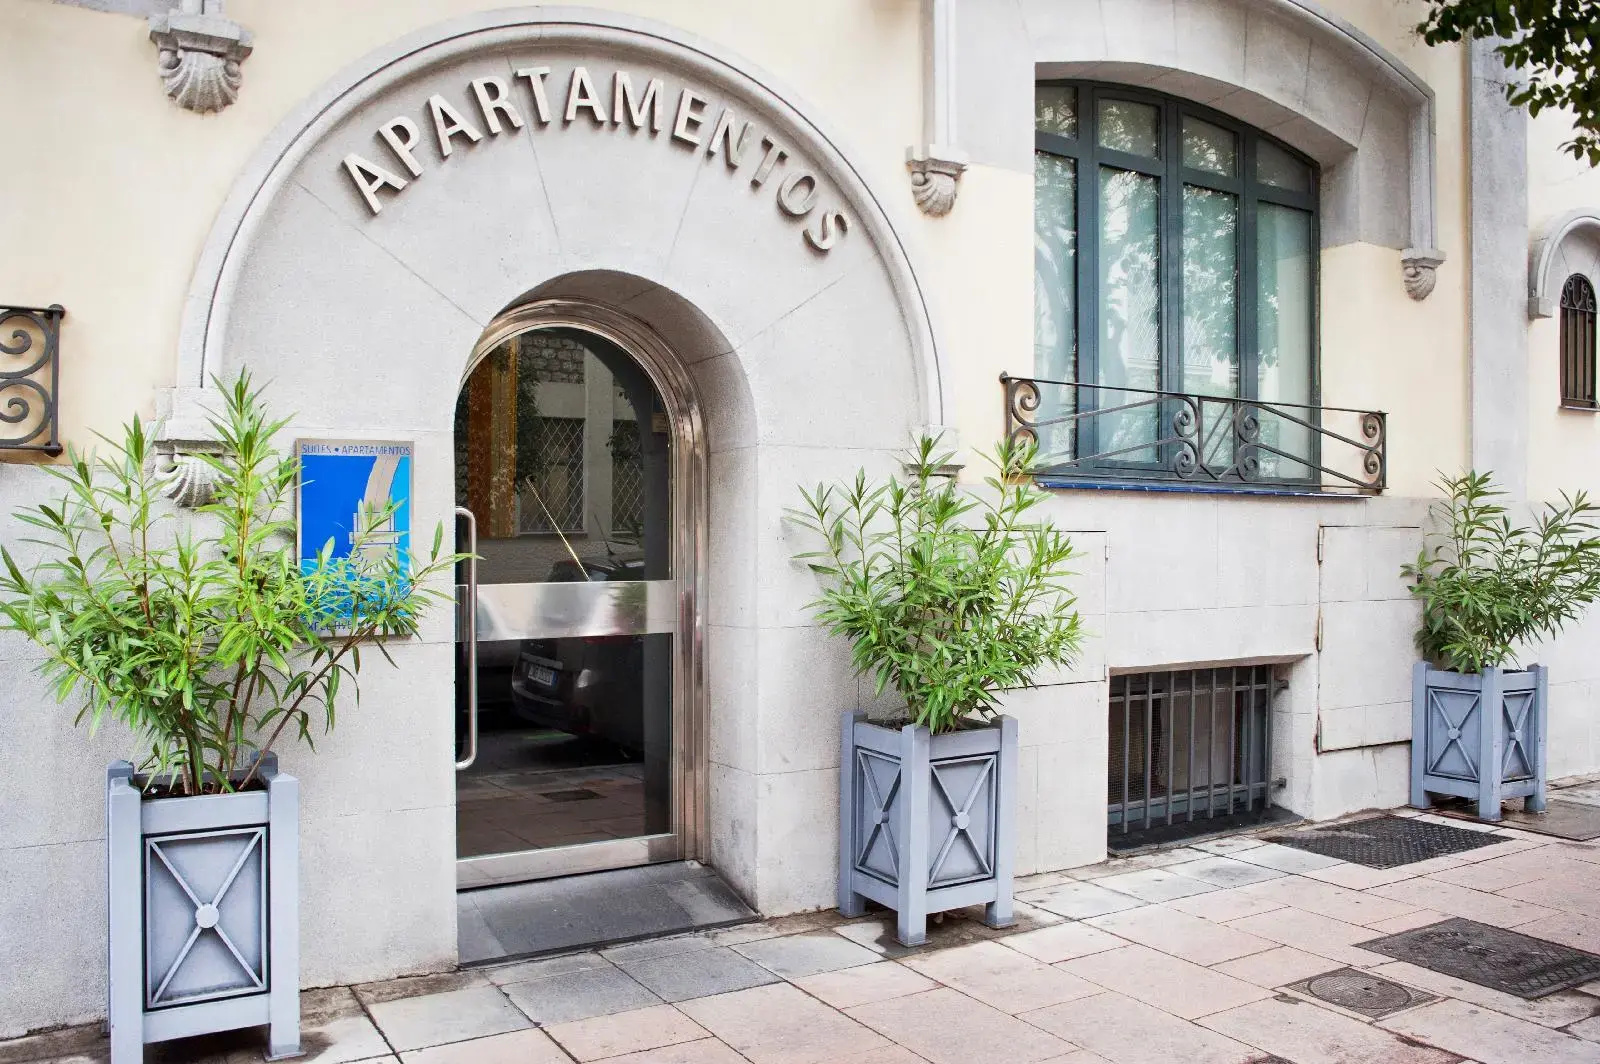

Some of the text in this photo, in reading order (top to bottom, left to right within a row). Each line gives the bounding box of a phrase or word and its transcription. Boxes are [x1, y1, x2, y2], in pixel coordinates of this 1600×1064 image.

[341, 66, 852, 252] APARTAMENTOS
[302, 444, 411, 456] SUITES APARTAMENTOS
